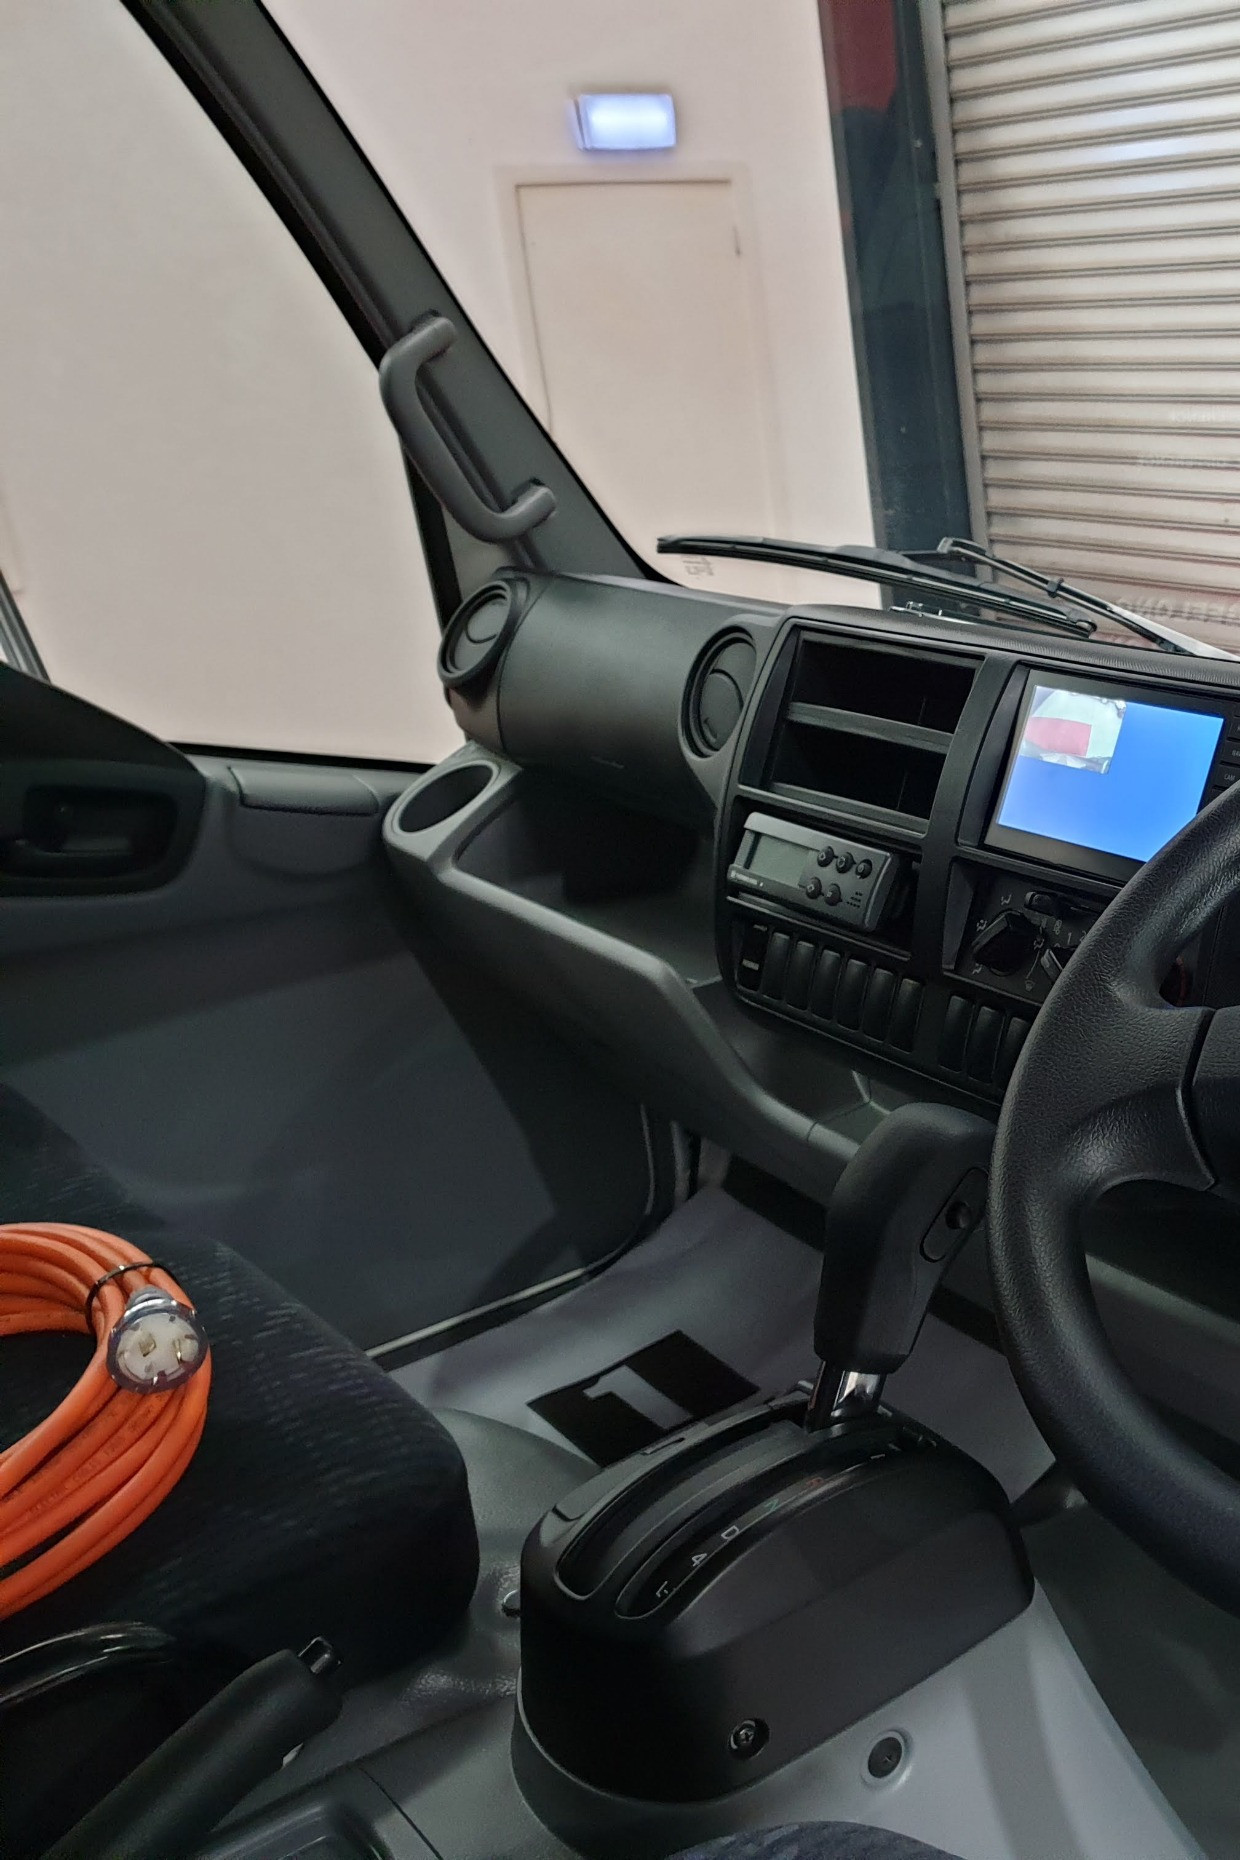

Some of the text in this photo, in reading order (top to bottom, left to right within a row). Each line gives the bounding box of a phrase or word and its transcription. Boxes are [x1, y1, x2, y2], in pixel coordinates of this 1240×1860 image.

[583, 1364, 695, 1431] 1
[720, 1525, 740, 1541] D
[691, 1552, 708, 1567] 4
